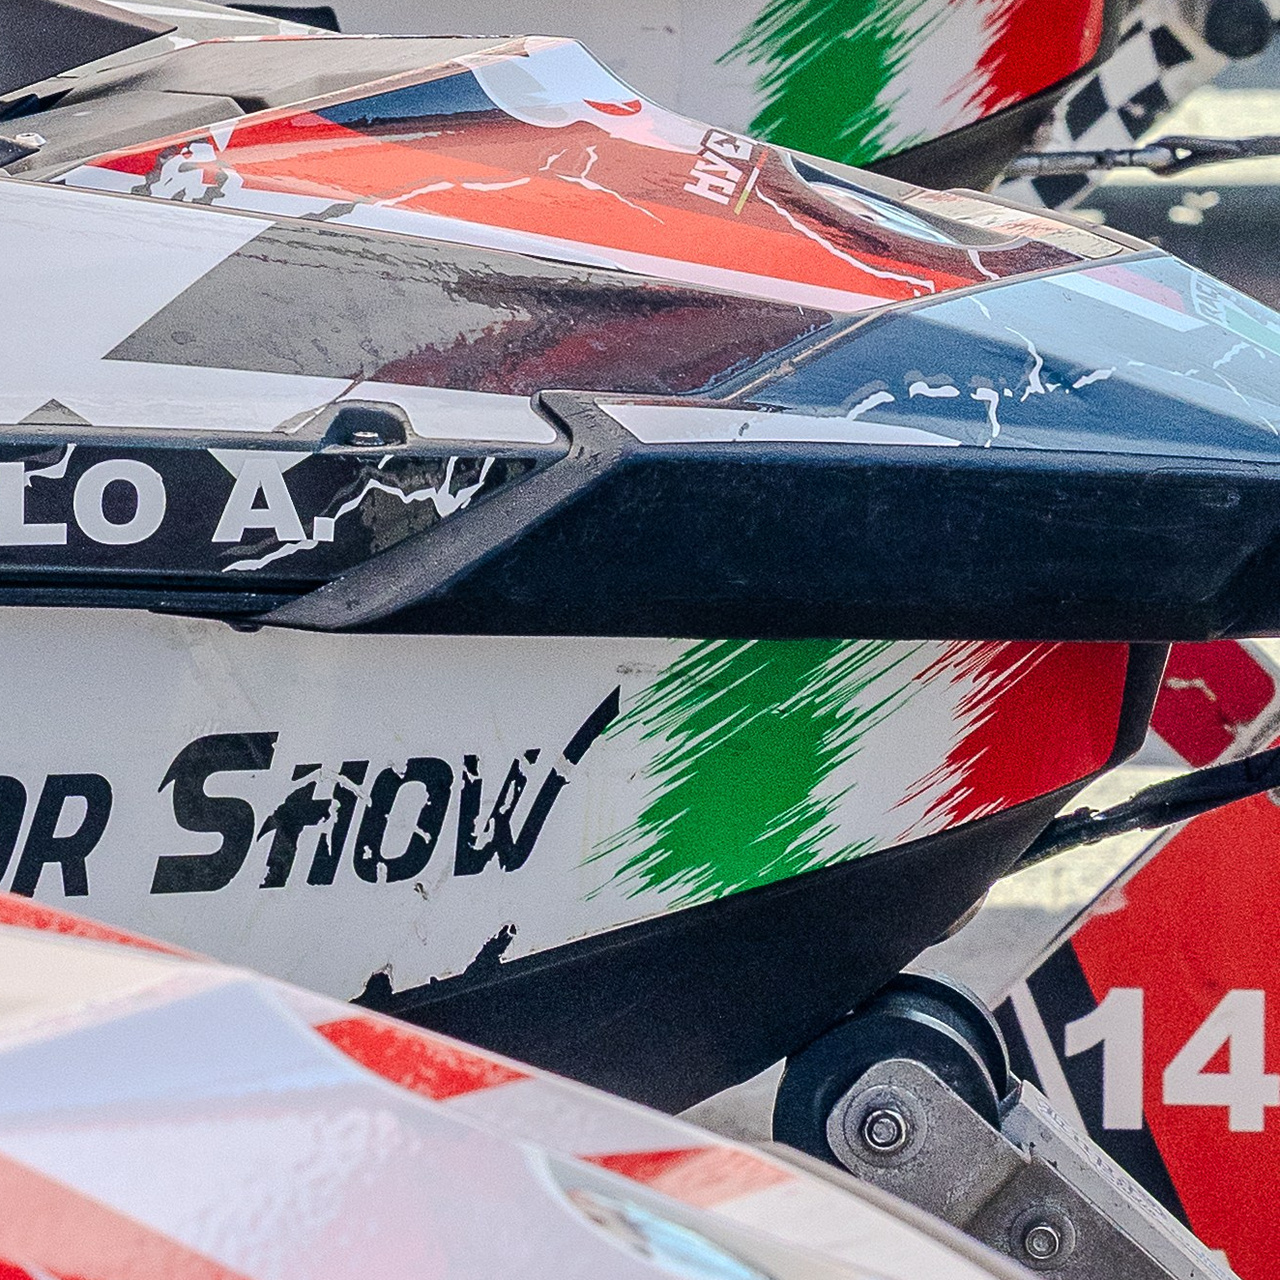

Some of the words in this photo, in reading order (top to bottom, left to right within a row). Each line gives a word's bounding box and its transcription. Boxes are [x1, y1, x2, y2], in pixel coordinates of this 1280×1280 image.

[211, 458, 336, 546] A.
[149, 684, 622, 895] SHOW
[1063, 986, 1280, 1133] 14
